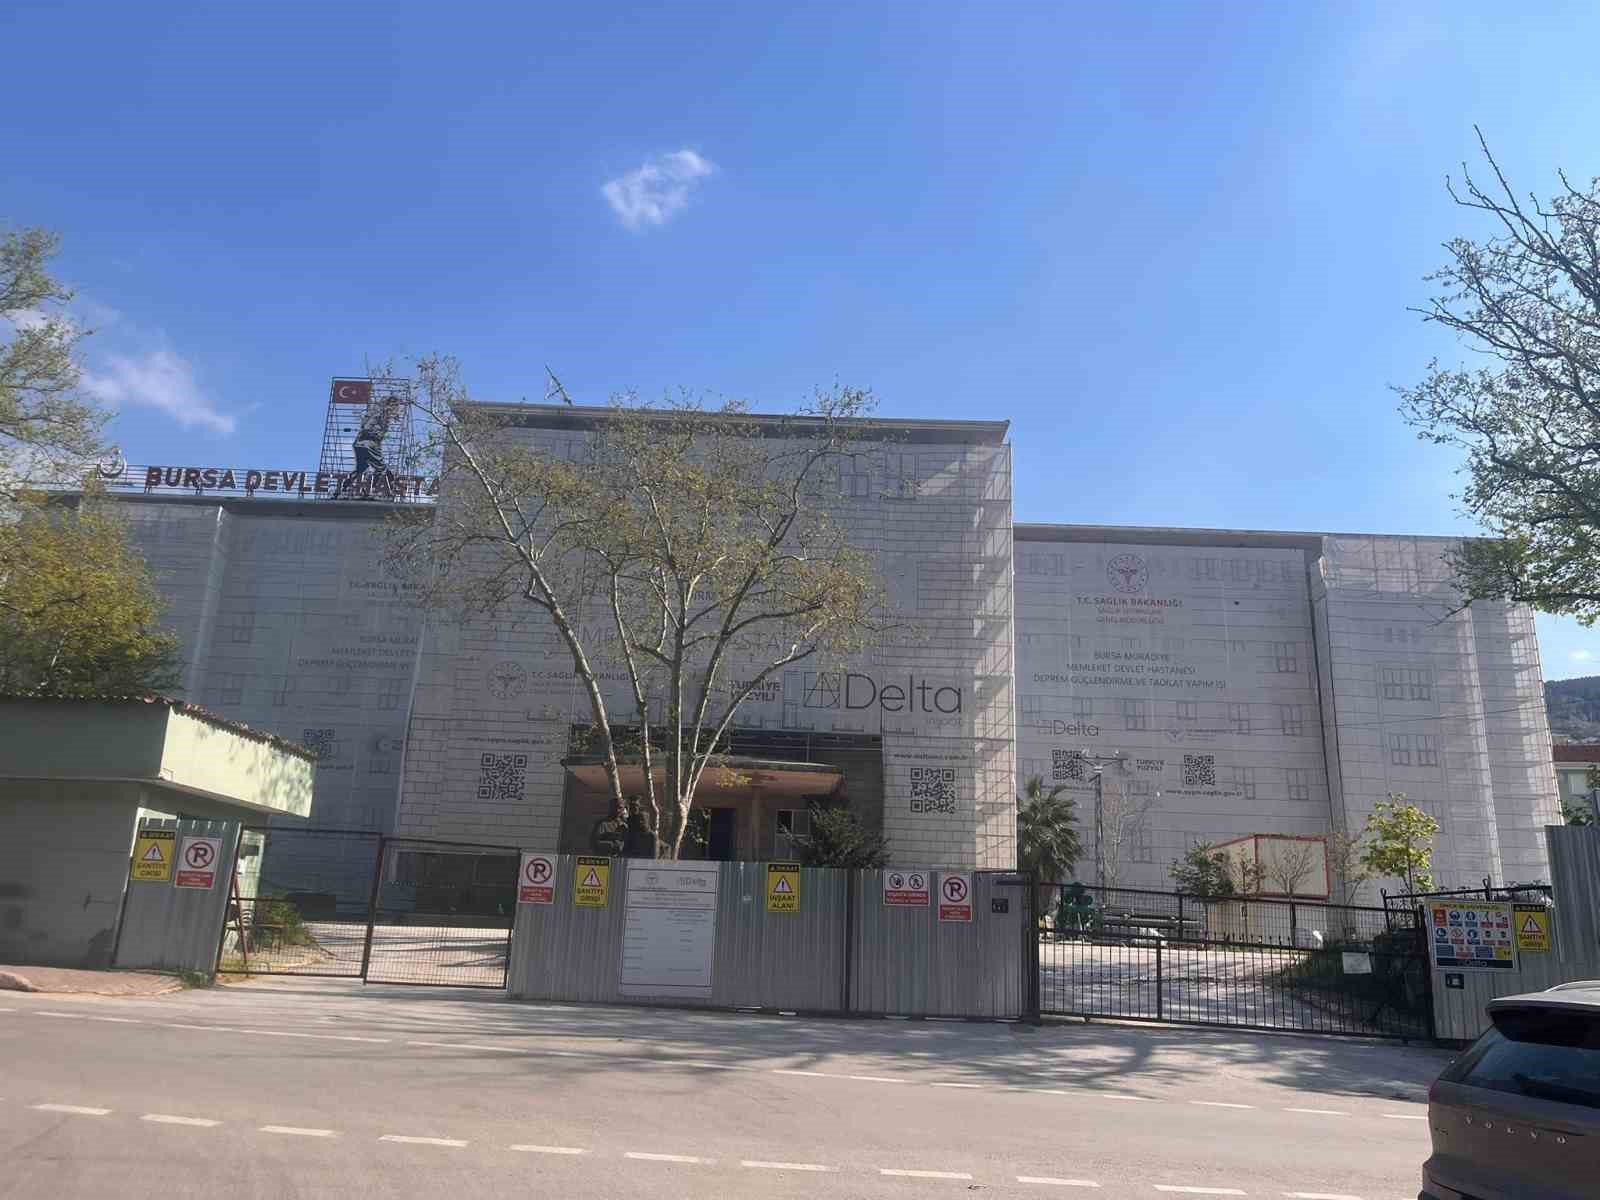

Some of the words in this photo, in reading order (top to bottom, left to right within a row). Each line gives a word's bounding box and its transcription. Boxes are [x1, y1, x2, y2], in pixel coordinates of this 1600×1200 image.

[146, 465, 236, 490] BURSA
[246, 471, 345, 495] DEVLET
[847, 674, 962, 713] Delta
[1053, 719, 1099, 737] Delta
